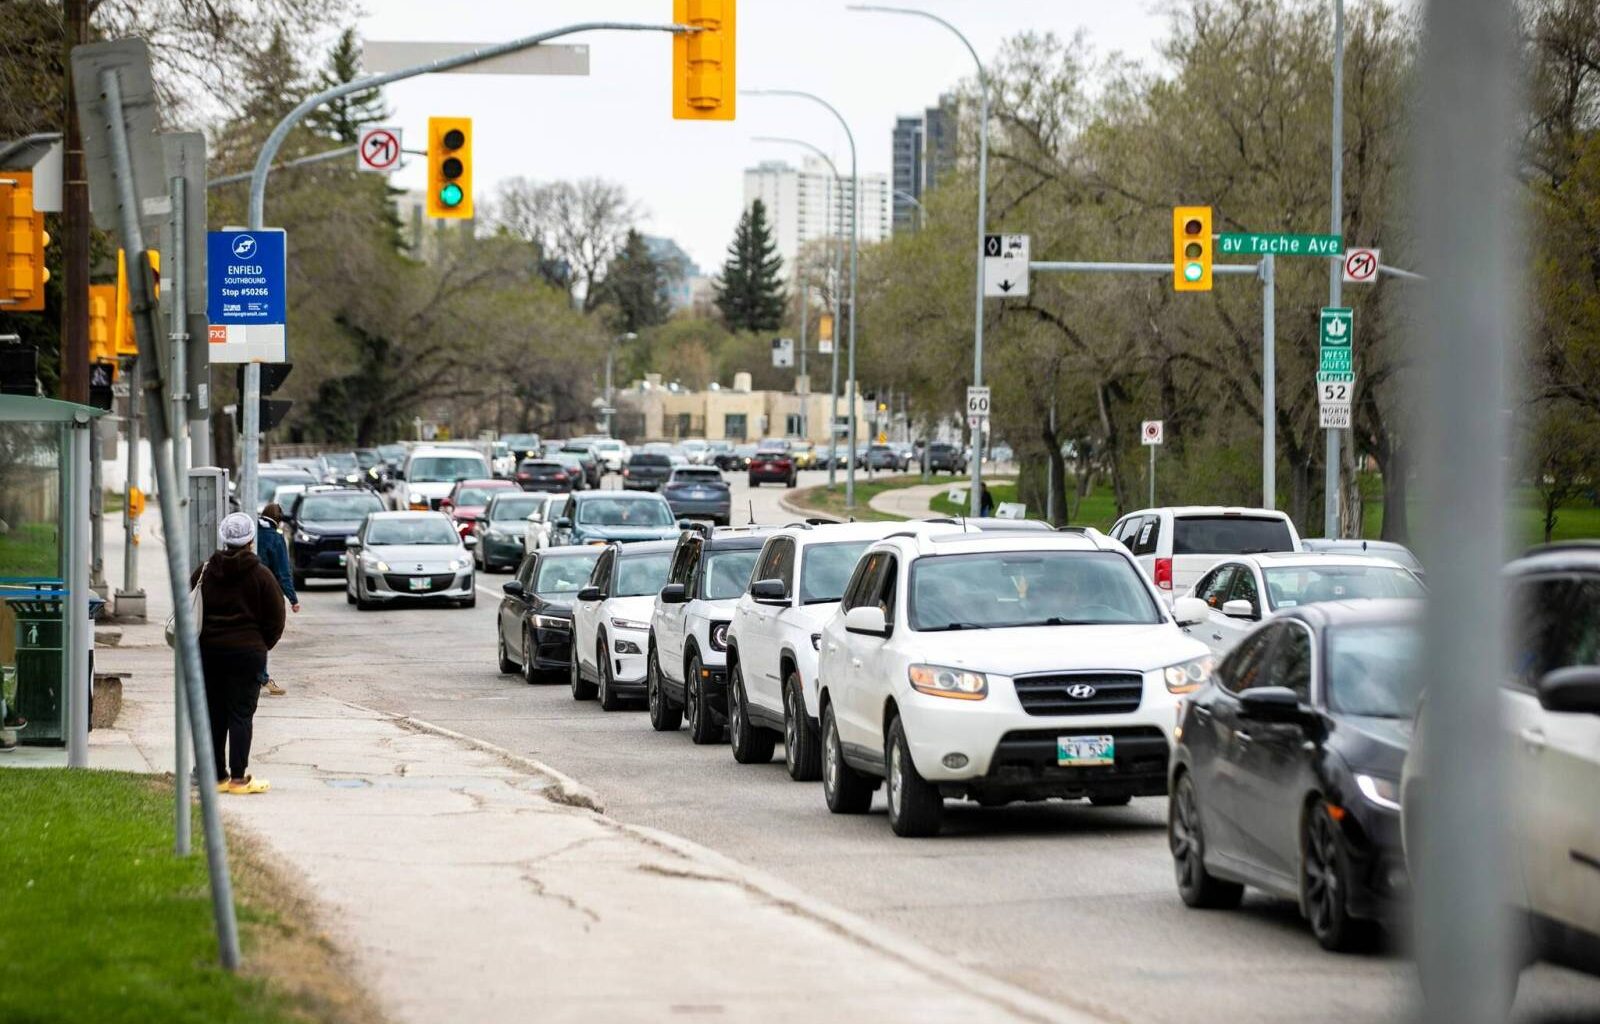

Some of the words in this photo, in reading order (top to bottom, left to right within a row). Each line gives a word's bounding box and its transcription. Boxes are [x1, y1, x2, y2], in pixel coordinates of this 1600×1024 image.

[1223, 237, 1242, 252] av
[1250, 236, 1299, 252] Tache
[1308, 238, 1338, 253] Ave
[228, 265, 263, 275] ENFIELD
[224, 277, 267, 285] SOUTHBOUND
[222, 288, 240, 297] Stop
[241, 288, 269, 296] #50266
[209, 330, 226, 339] FX2
[1324, 350, 1348, 360] WEST
[1322, 360, 1350, 370] OUEST
[1325, 385, 1346, 400] 52
[969, 397, 988, 411] 60
[1322, 406, 1349, 416] NORTH
[1324, 418, 1347, 427] NORD
